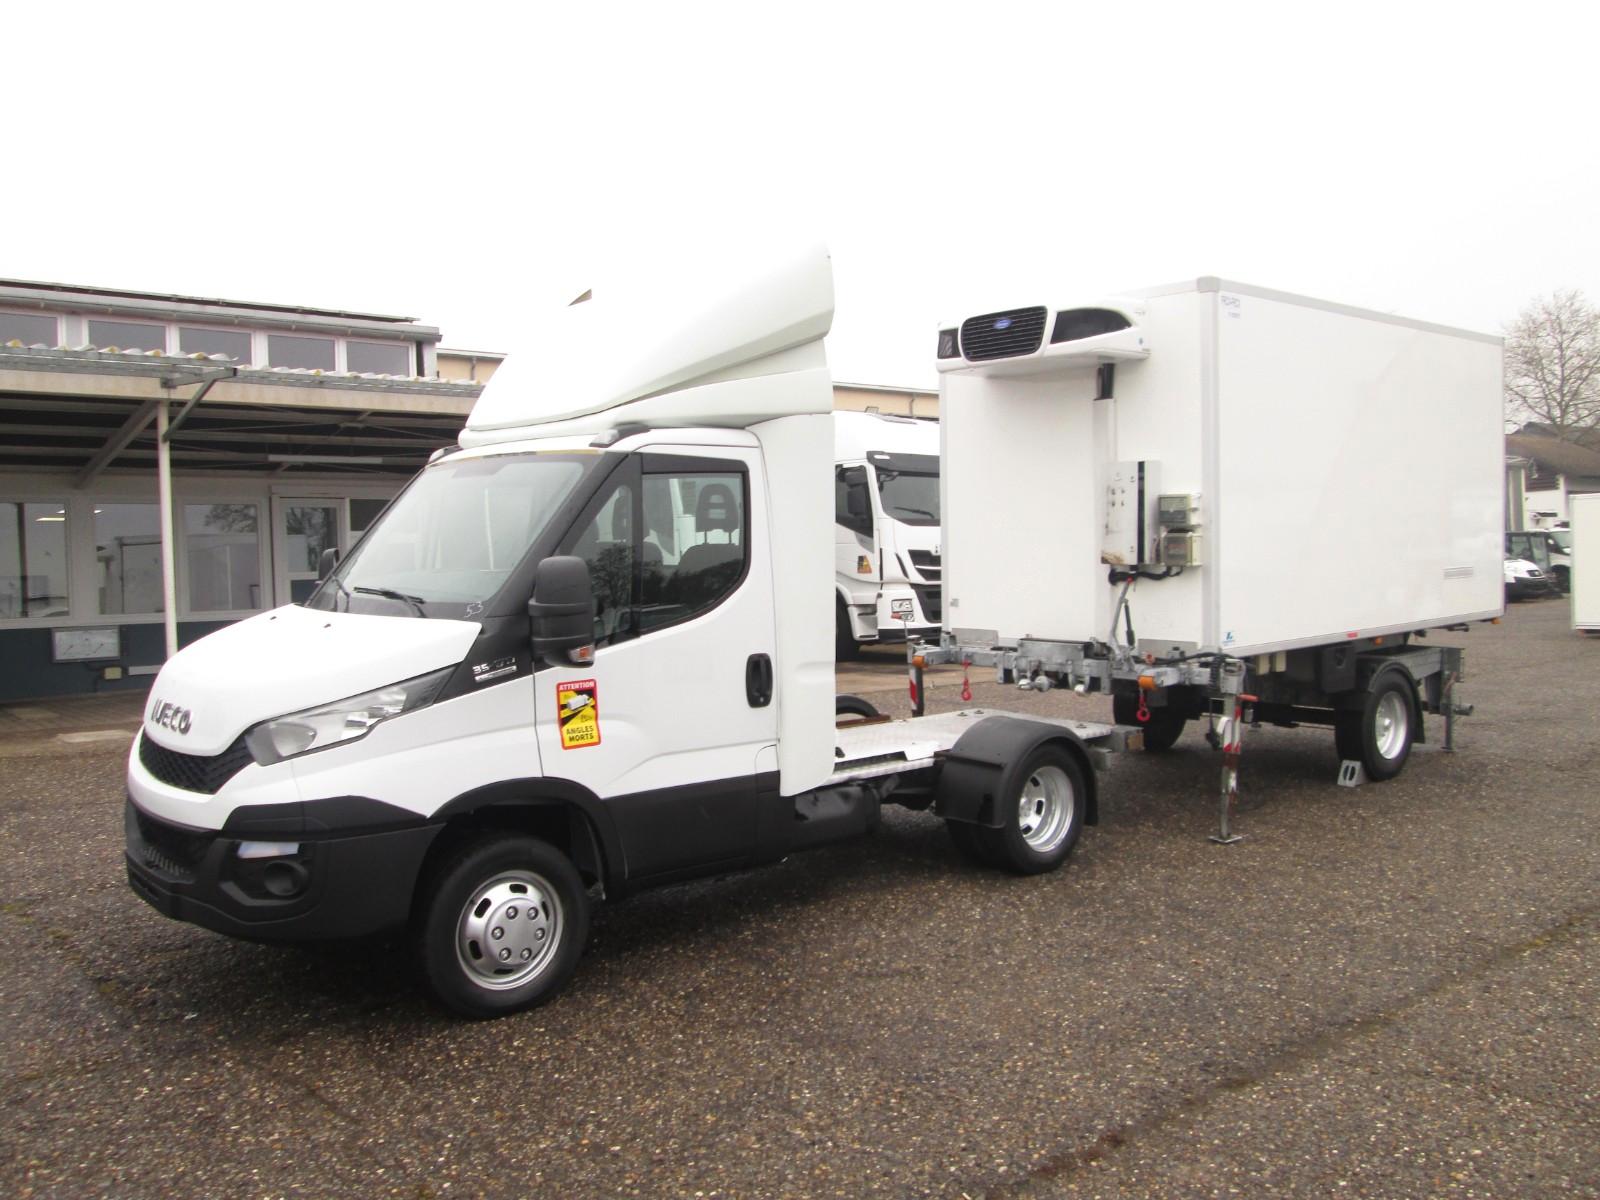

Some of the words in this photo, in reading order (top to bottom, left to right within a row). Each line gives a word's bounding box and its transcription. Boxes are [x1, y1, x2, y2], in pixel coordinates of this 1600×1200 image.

[559, 681, 595, 691] ATTENTION
[151, 698, 192, 735] IVECO
[566, 725, 594, 735] ANGLES
[568, 733, 594, 742] MORTS
